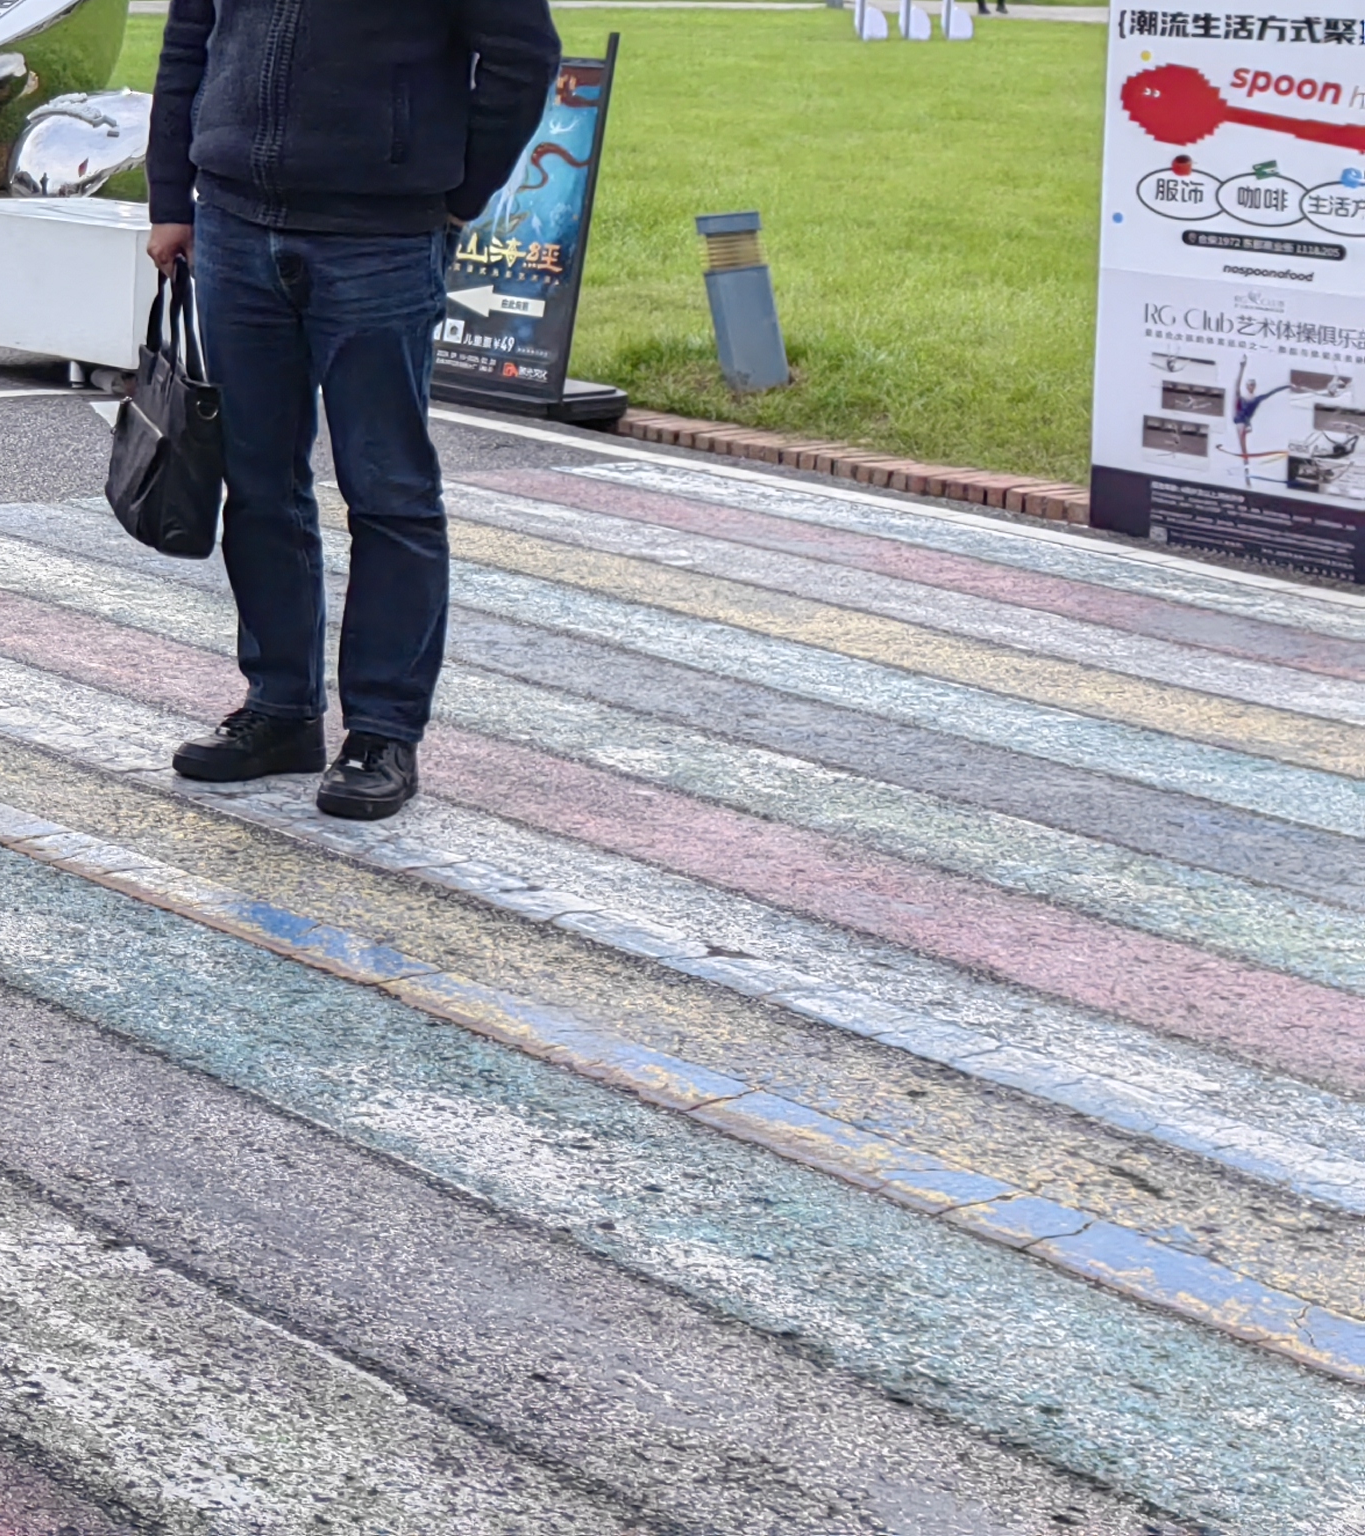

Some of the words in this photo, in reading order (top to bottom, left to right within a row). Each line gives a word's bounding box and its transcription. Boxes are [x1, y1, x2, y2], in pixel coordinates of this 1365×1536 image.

[1118, 9, 1365, 45] {潮流生活方式聚
[1231, 67, 1342, 105] spoon
[1155, 178, 1205, 204] 服饰
[1237, 186, 1289, 213] 咖啡
[1144, 302, 1176, 327] RG
